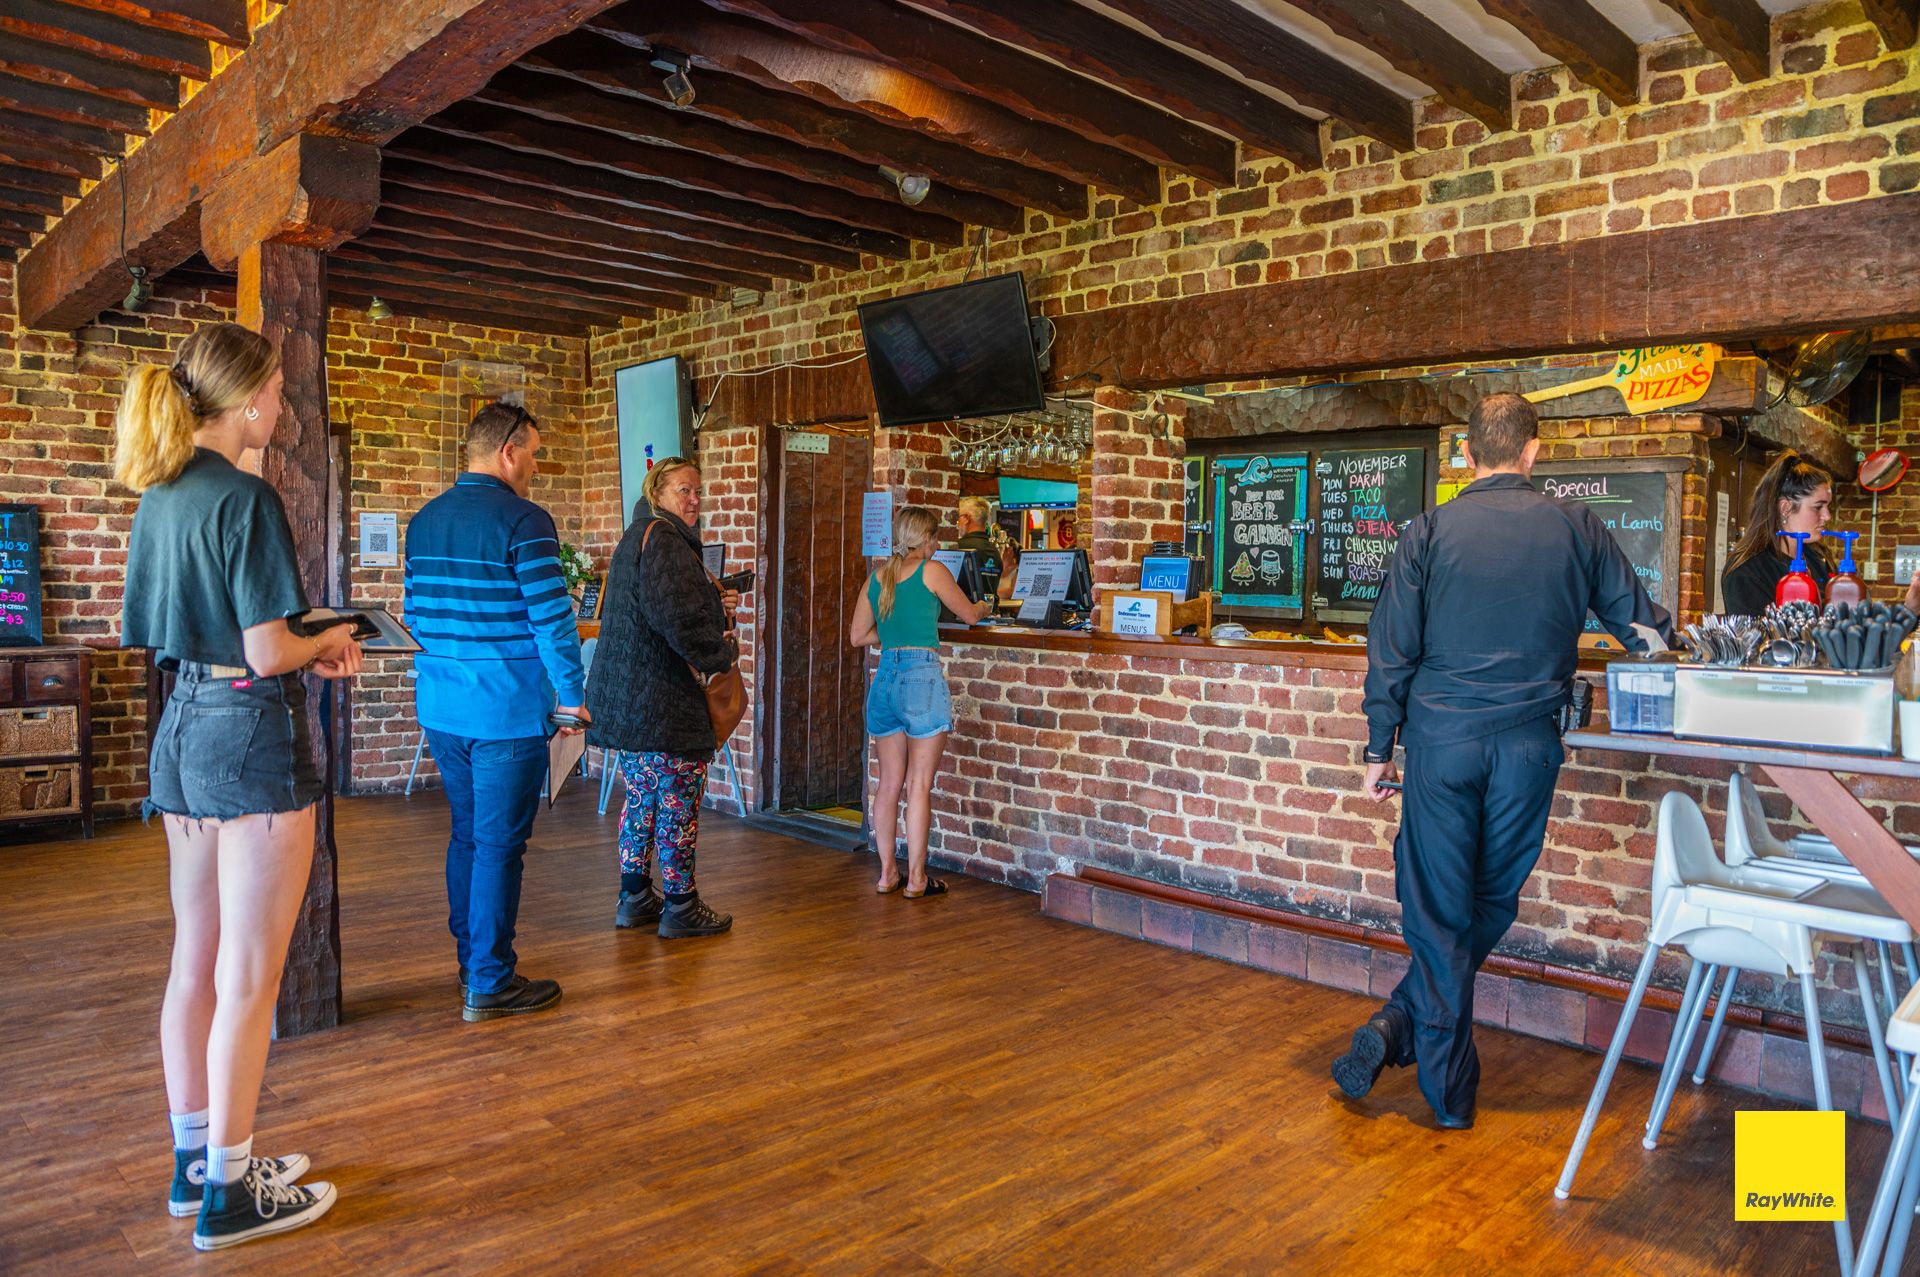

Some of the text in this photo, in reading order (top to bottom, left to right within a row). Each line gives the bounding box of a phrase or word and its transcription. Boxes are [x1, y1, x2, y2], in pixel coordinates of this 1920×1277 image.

[1639, 356, 1688, 379] MADE
[1627, 363, 1711, 400] PIZZAS
[1338, 455, 1407, 475] NOVEMBER
[1323, 472, 1385, 491] MON PARMI
[1541, 477, 1608, 498] Special
[1321, 487, 1381, 505] TUES TACO
[1230, 501, 1279, 521] BEER
[1322, 504, 1389, 520] WED PIZZA
[1321, 520, 1398, 539] THURS STEAK
[1621, 512, 1664, 532] Lamb
[1233, 523, 1293, 546] GARDEN
[1323, 538, 1341, 550] FRI
[1323, 551, 1384, 569] SAT CURRY
[1148, 575, 1180, 588] MENU
[1323, 564, 1388, 582] SUN ROAST
[1120, 624, 1148, 634] MENU'S
